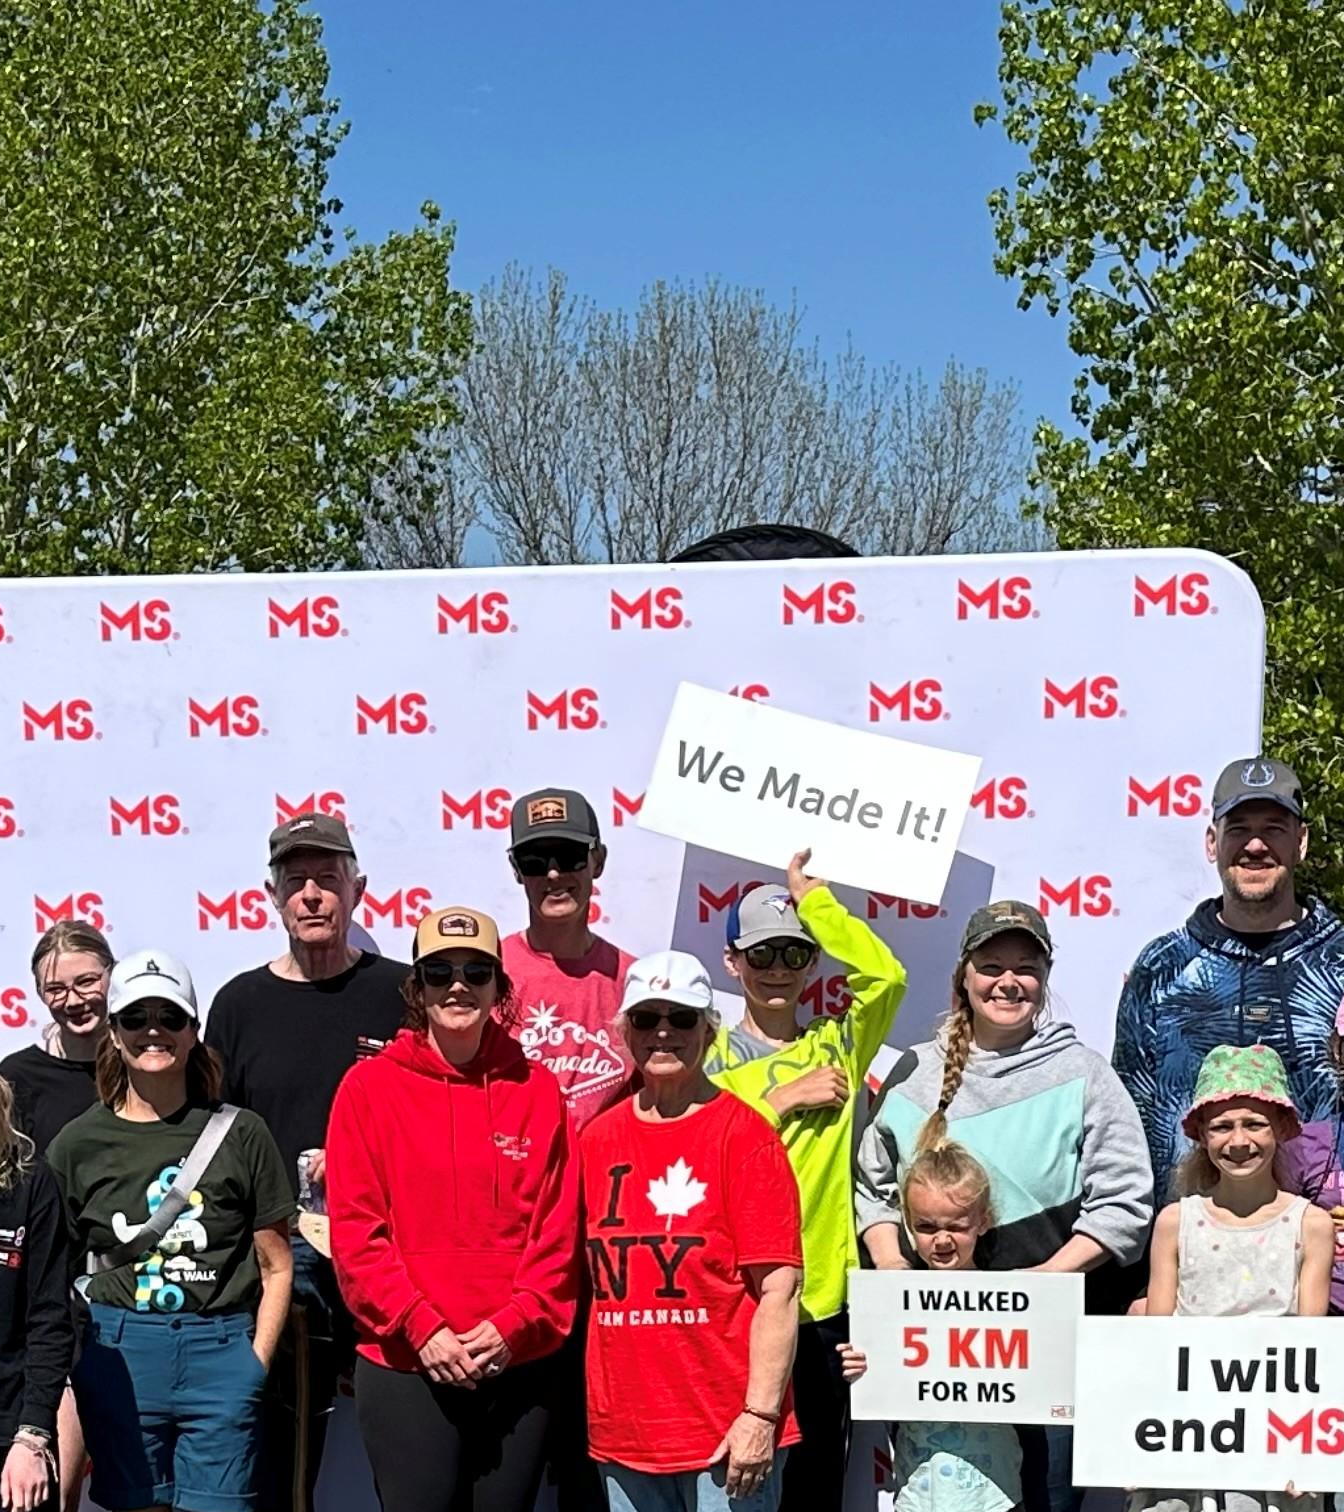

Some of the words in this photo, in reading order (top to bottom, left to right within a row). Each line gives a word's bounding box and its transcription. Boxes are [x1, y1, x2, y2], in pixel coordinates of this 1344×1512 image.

[438, 592, 509, 634] MS
[611, 587, 683, 629] MS
[783, 581, 856, 624] MS
[957, 576, 1031, 619] MS
[1134, 573, 1209, 616] MS
[101, 599, 172, 641] MS
[269, 596, 340, 637] MS
[189, 695, 260, 737] MS
[357, 693, 428, 734] MS
[527, 688, 599, 730] MS
[869, 679, 942, 721] MS
[1044, 676, 1118, 718] MS
[23, 699, 94, 741] MS
[442, 788, 513, 830] MS
[613, 786, 645, 827] M
[678, 739, 745, 793] We
[757, 765, 884, 830] Made
[896, 799, 947, 844] It!
[1128, 774, 1201, 817] MS
[110, 794, 181, 836] MS
[197, 890, 268, 931] MS
[1039, 875, 1112, 917] MS
[599, 1163, 633, 1228] I
[183, 1269, 217, 1282] WALK
[587, 1235, 706, 1301] NY
[628, 1307, 710, 1327] CANADA
[902, 1289, 910, 1311] I
[918, 1289, 1030, 1313] WALKED
[902, 1326, 930, 1369] 5
[948, 1327, 1029, 1369] KM
[1177, 1346, 1189, 1392] I
[1210, 1345, 1321, 1394] will
[917, 1381, 967, 1403] FOR
[977, 1381, 1016, 1404] MS
[1134, 1407, 1246, 1454] end
